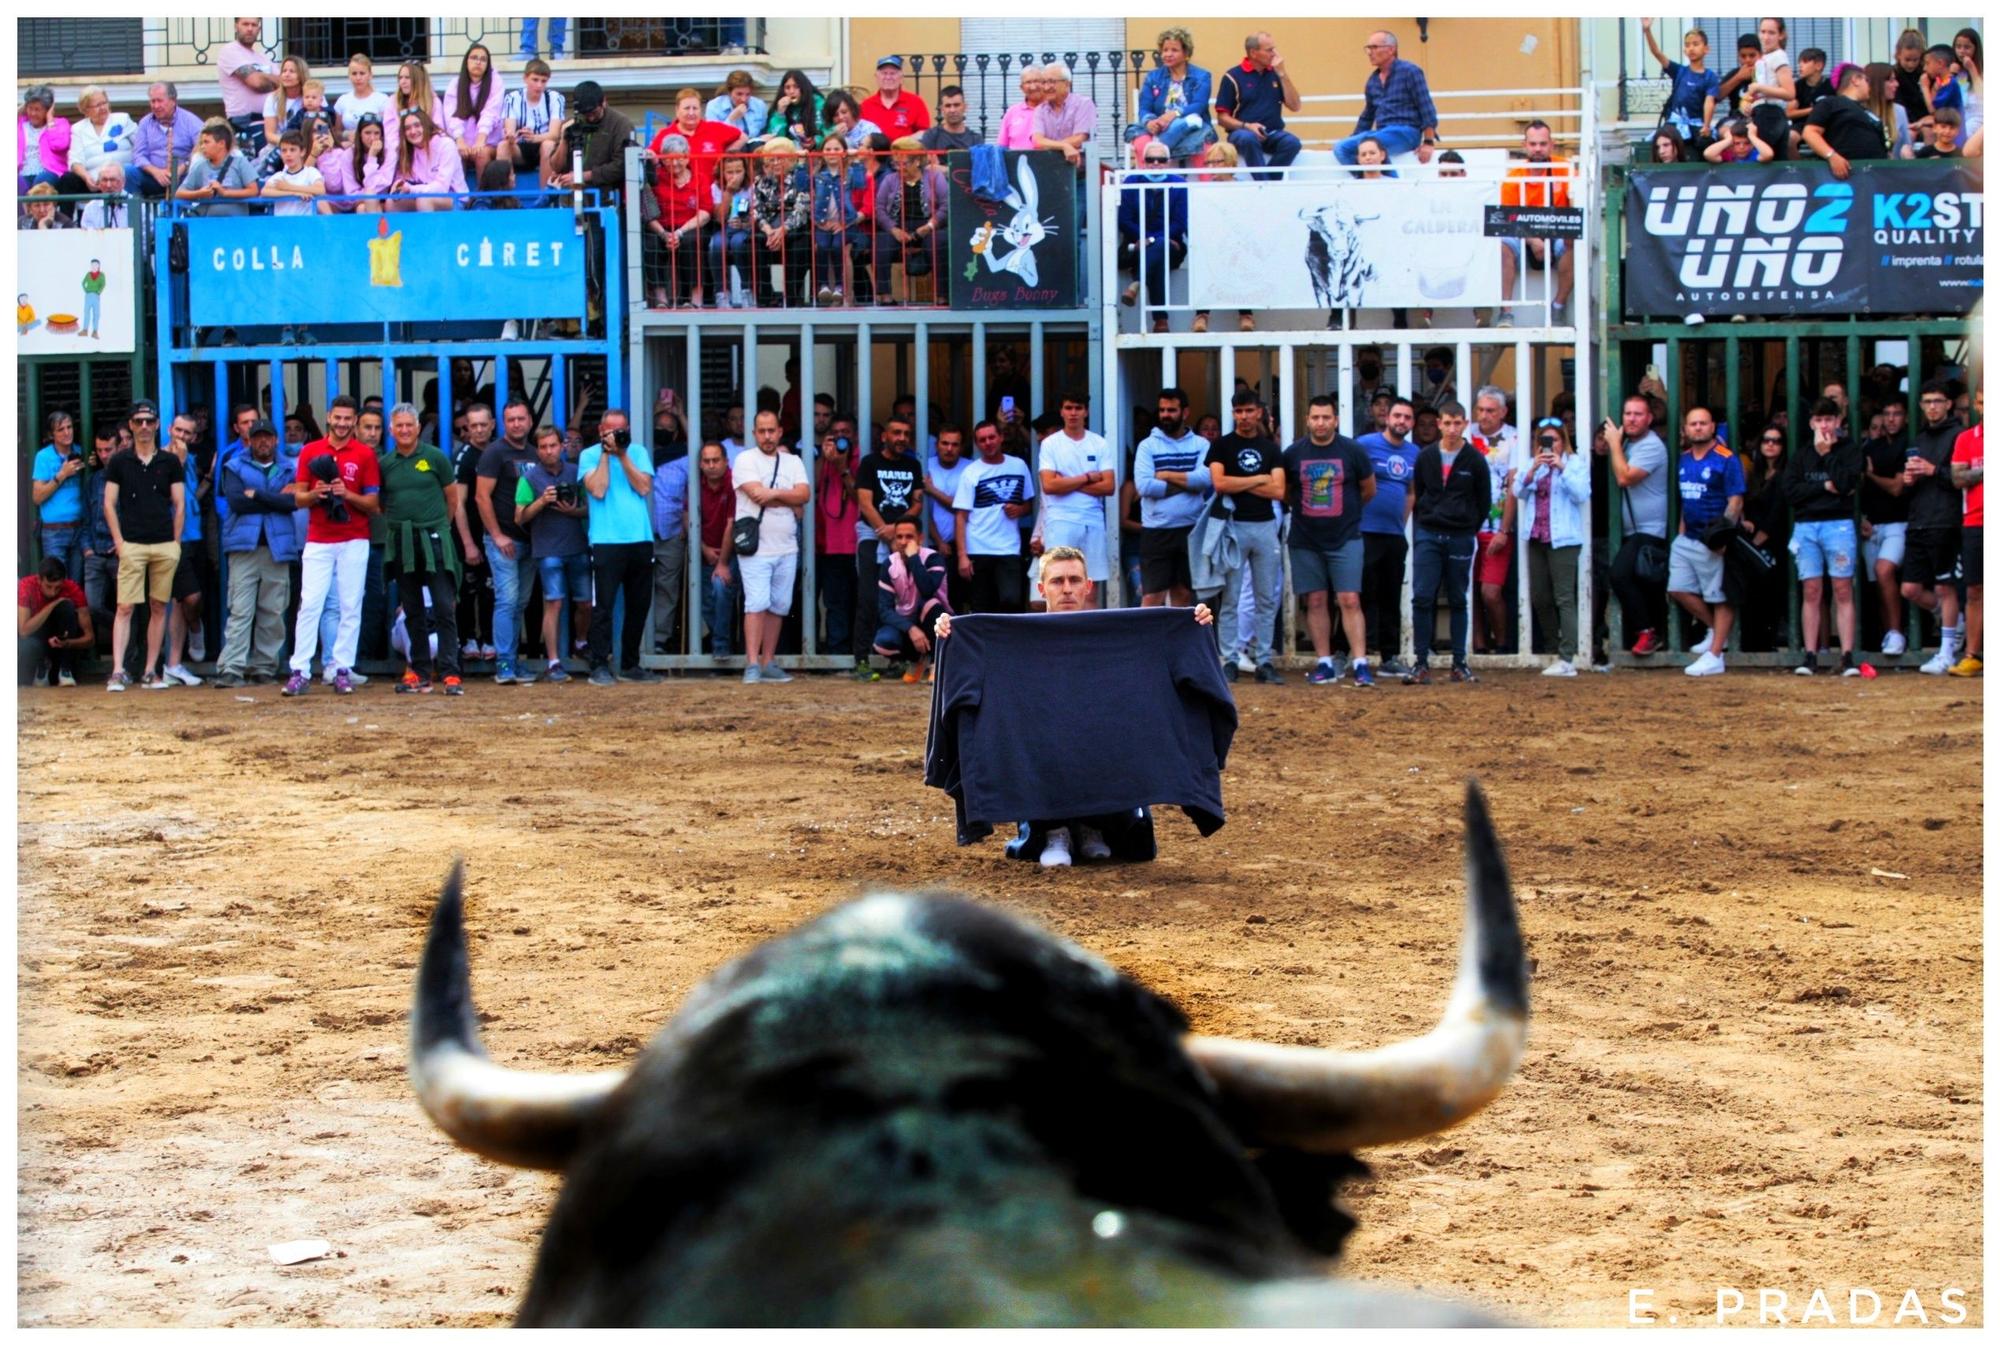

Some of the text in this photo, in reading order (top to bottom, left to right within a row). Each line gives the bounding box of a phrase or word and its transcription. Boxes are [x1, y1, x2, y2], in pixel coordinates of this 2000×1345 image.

[1644, 183, 1855, 236] UNO2
[1401, 219, 1480, 235] CALDERA
[1873, 228, 1977, 246] QUALITY
[212, 244, 305, 272] COLLA
[1679, 236, 1844, 288] UNO
[1891, 255, 1943, 269] imprenta
[971, 286, 1059, 306] Bugs Bunny
[1675, 290, 1836, 302] AUTODEFENSA
